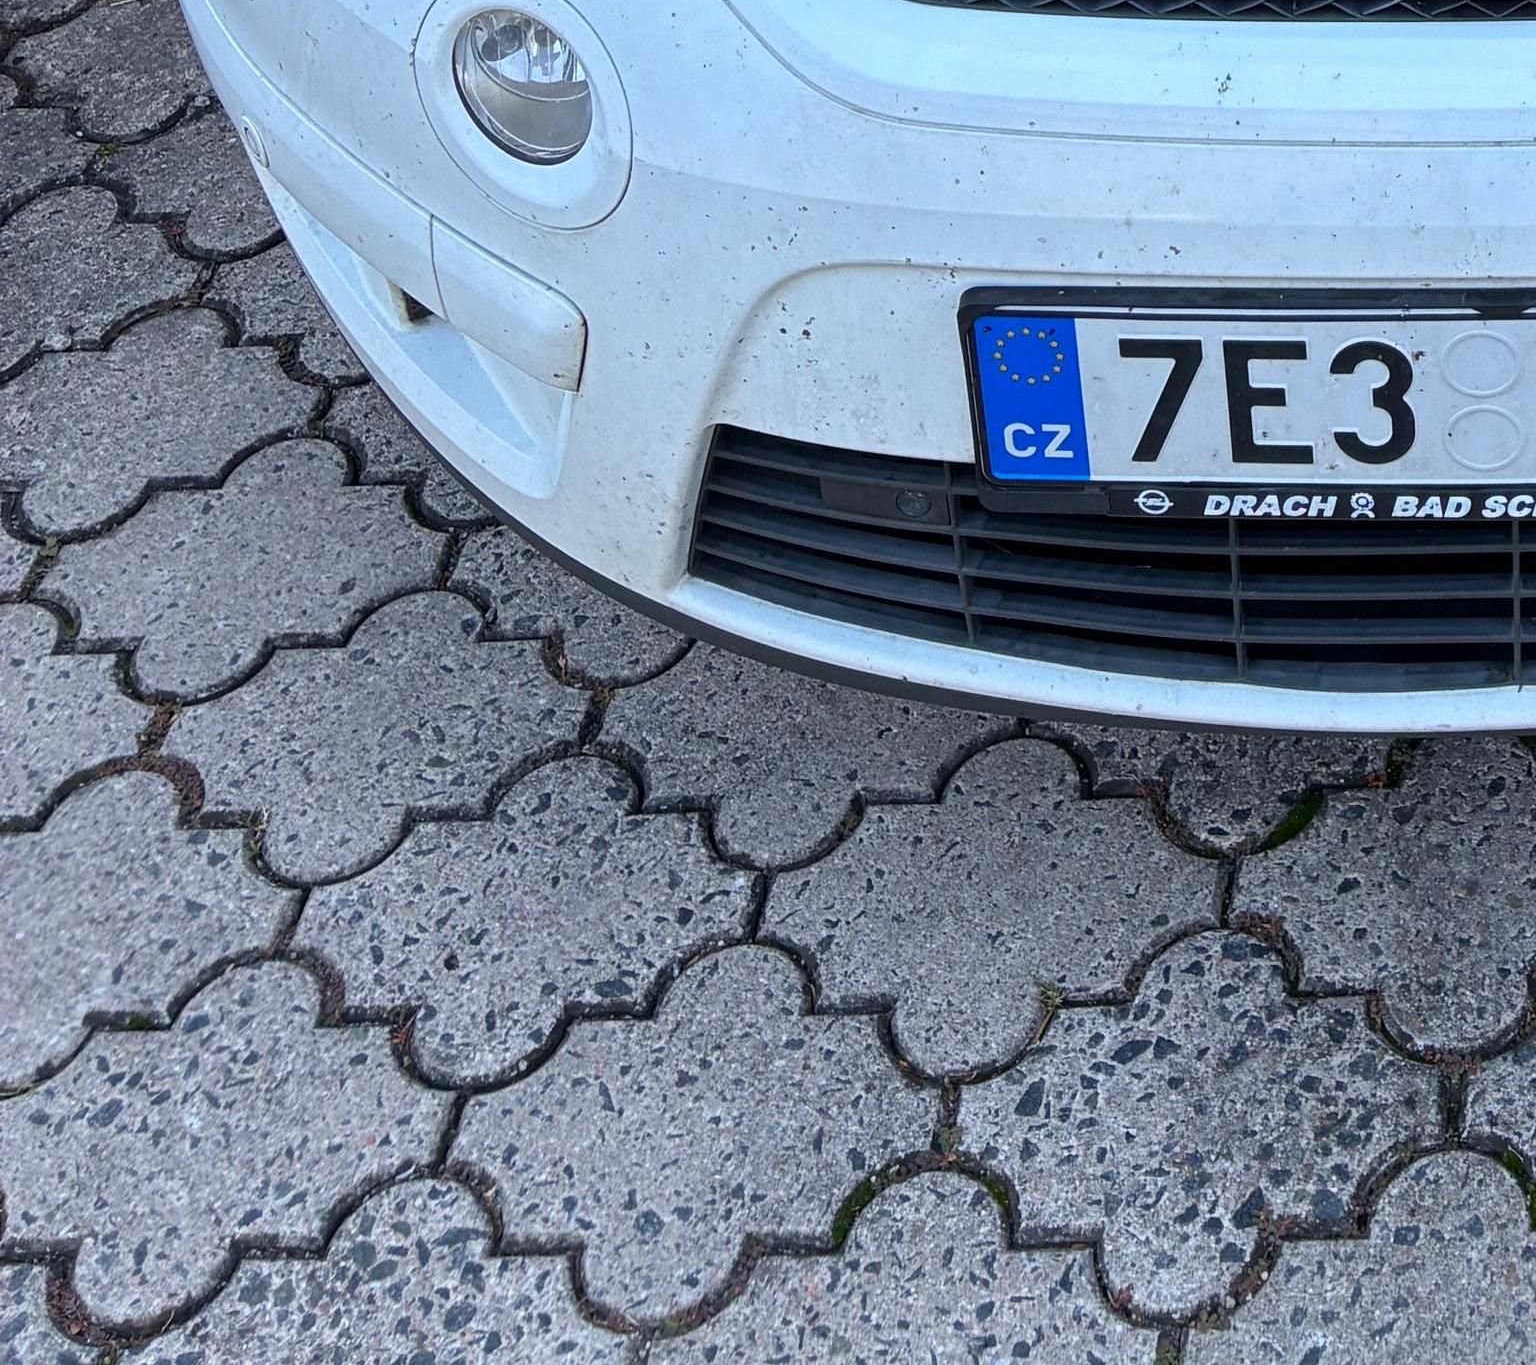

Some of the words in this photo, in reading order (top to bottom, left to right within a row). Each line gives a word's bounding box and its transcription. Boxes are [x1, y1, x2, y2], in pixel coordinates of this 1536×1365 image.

[1118, 335, 1416, 465] 7E3
[1003, 422, 1074, 459] CZ
[1203, 494, 1338, 517] DRACH
[1391, 496, 1472, 518] BAD
